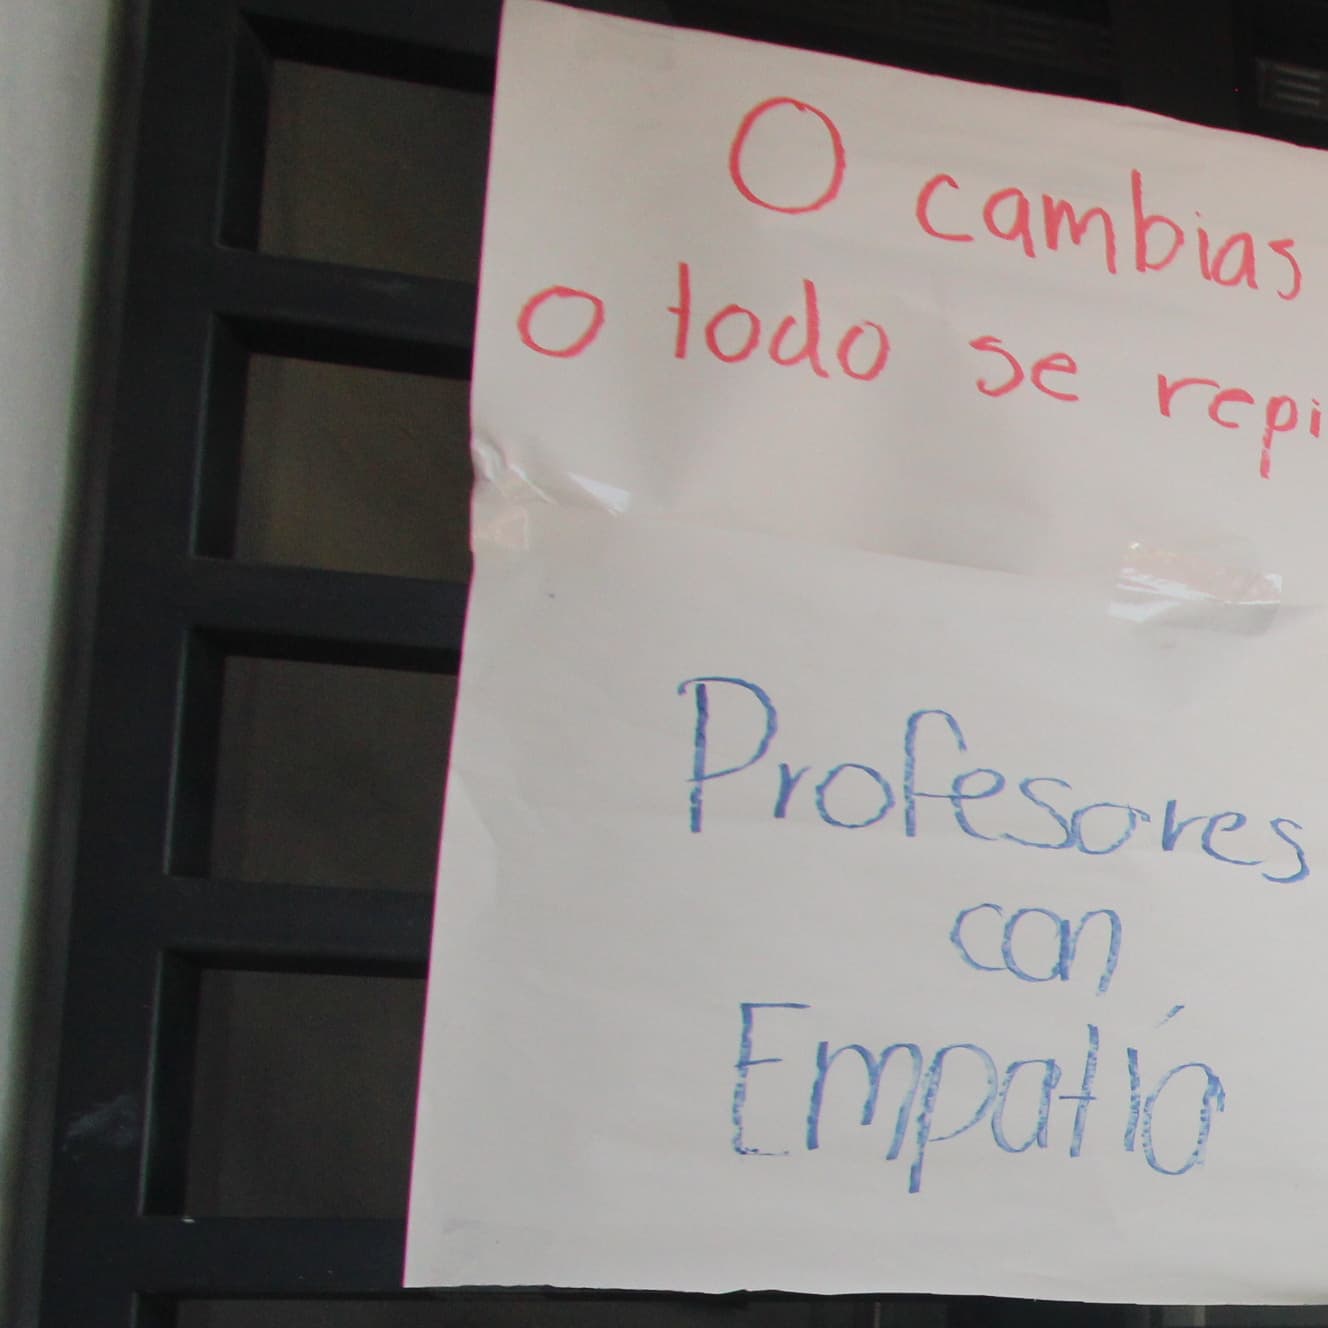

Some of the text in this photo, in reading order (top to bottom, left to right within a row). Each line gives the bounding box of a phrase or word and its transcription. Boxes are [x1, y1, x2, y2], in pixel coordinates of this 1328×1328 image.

[728, 96, 1304, 301] O cambias
[667, 262, 892, 381] todo
[972, 333, 1080, 402] se
[675, 675, 1312, 885] Profesores
[949, 902, 1123, 997] con
[730, 1002, 1228, 1196] Empatía
